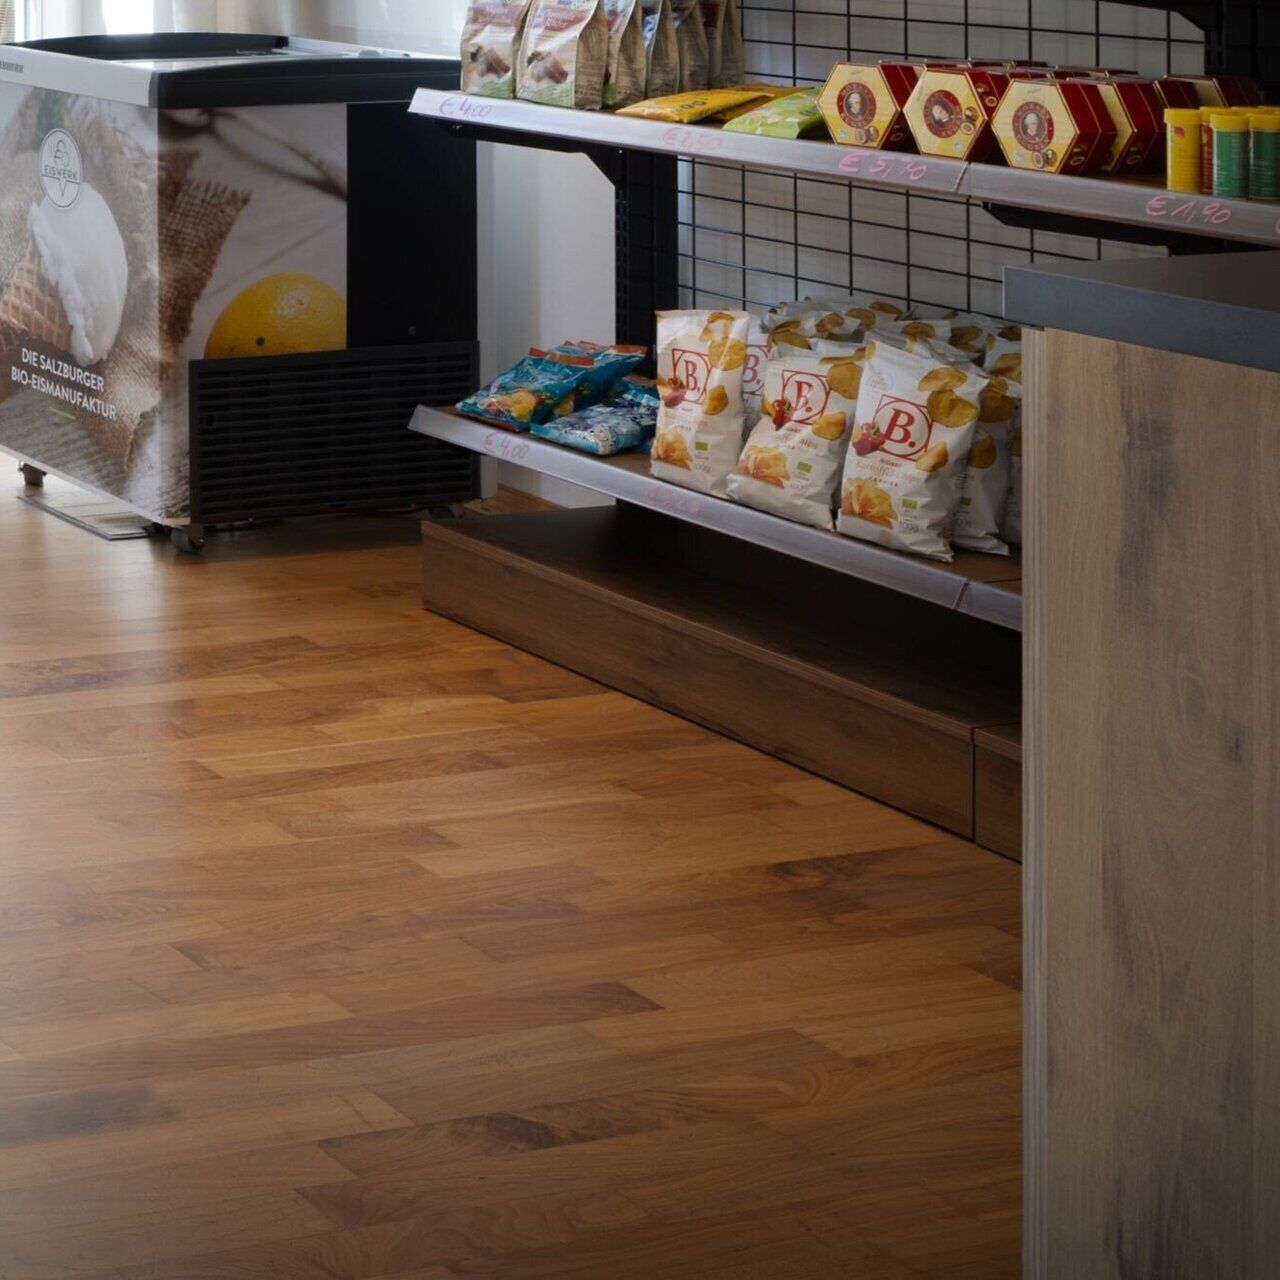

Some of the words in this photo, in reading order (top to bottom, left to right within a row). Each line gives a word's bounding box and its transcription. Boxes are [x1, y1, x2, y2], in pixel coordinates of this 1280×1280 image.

[439, 96, 456, 115] €
[458, 99, 493, 117] 4,00
[44, 165, 77, 180] EISWERK
[839, 152, 870, 172] €
[1145, 195, 1175, 216] €
[1171, 200, 1232, 224] 1,90
[21, 347, 39, 367] DIE
[39, 355, 105, 393] SALZBURGER
[11, 366, 117, 421] BIO-EISMANUFAKTUR
